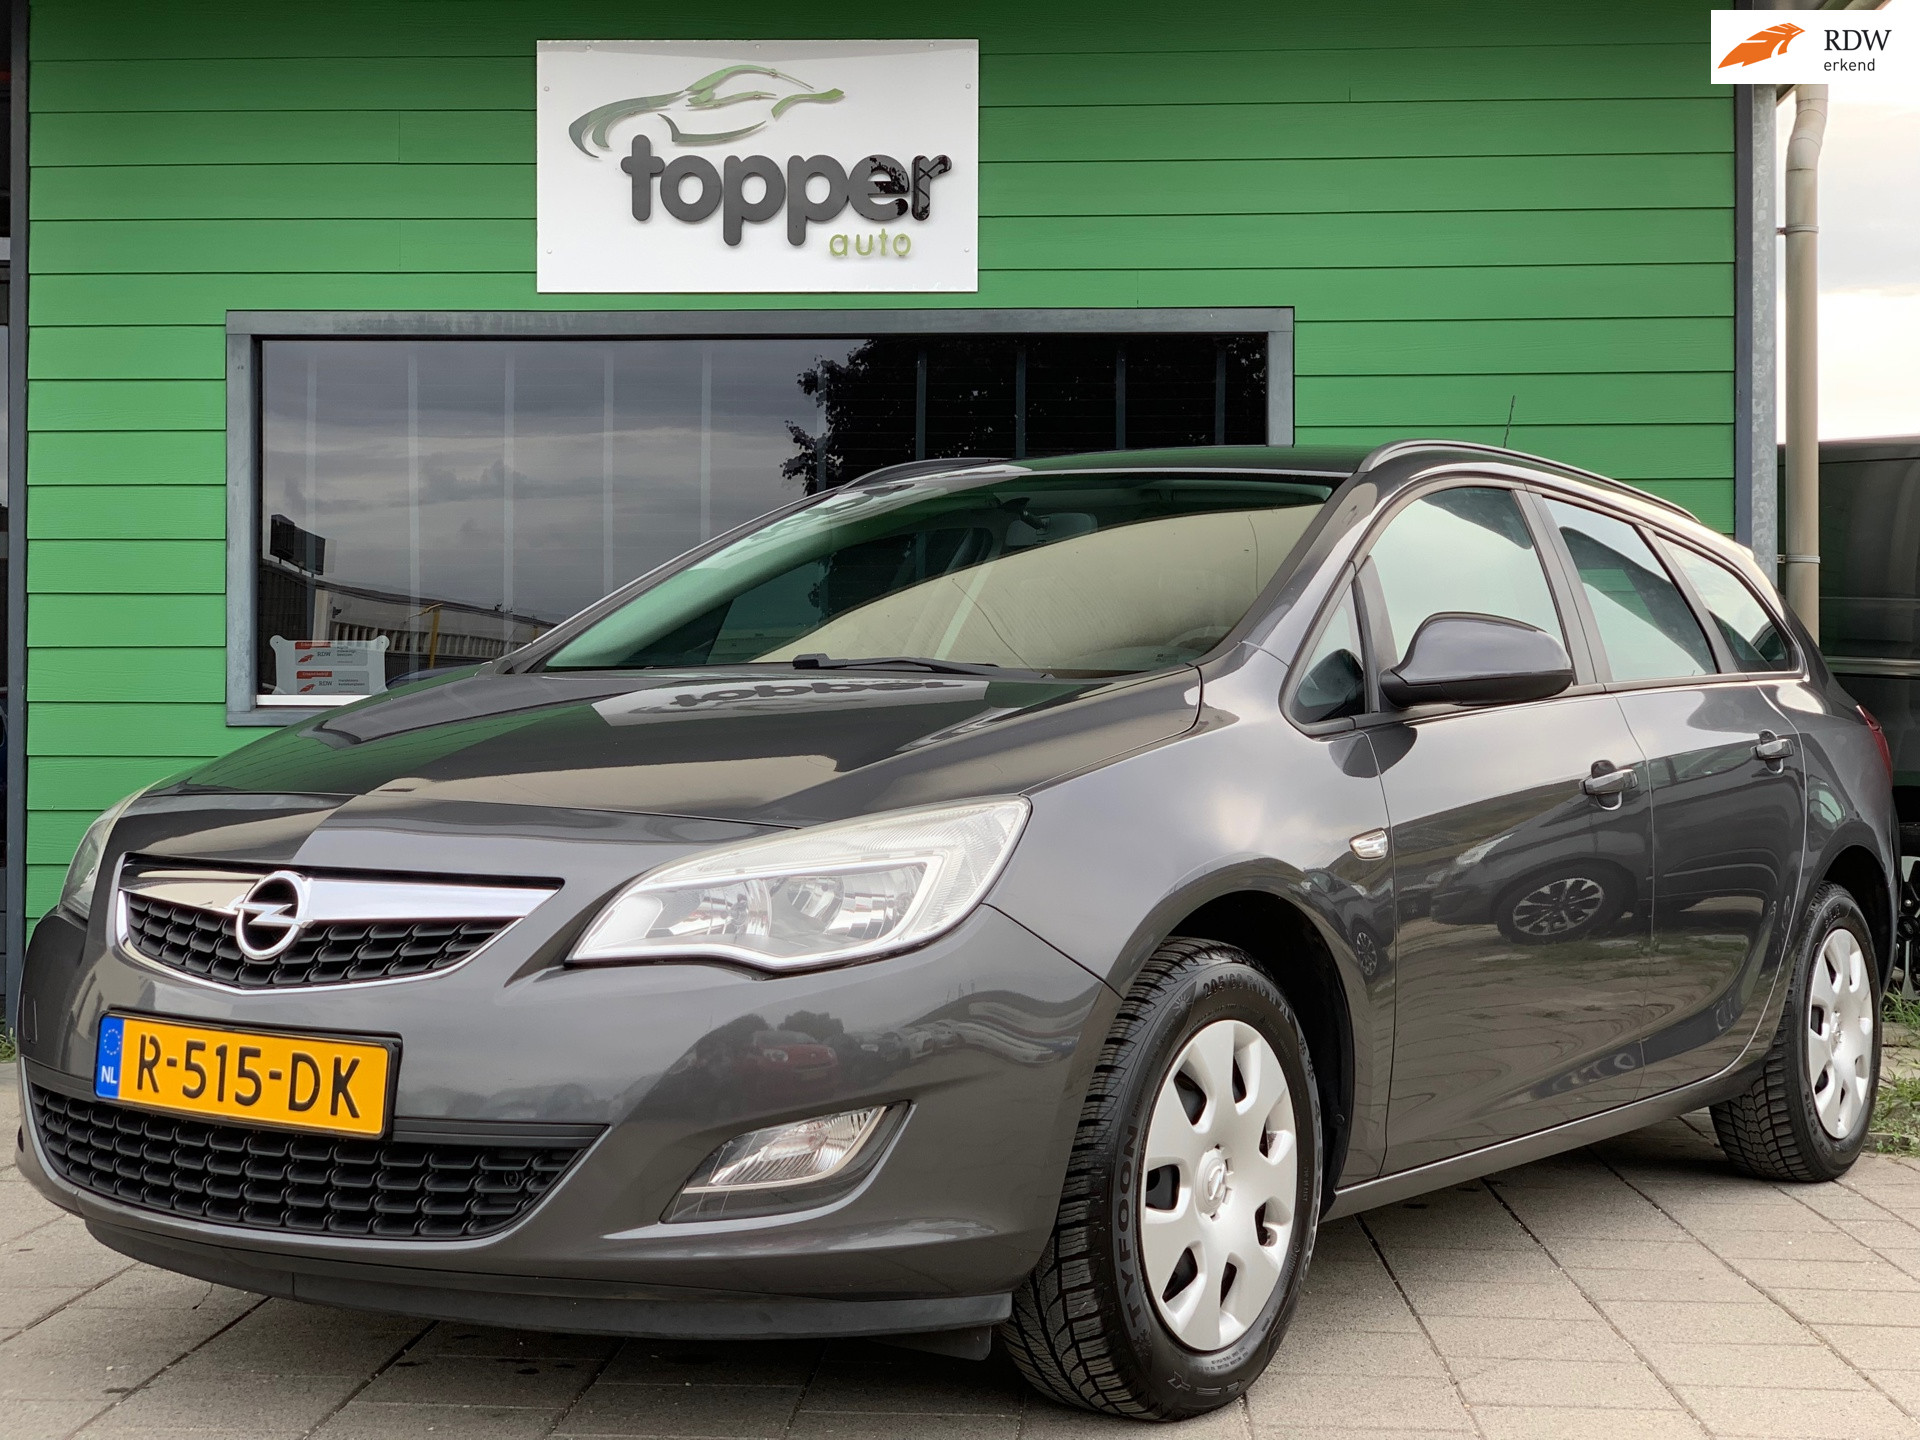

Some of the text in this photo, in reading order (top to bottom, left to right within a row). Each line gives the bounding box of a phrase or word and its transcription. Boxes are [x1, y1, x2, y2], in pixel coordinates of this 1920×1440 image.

[620, 134, 952, 246] topper
[829, 228, 911, 256] auto
[100, 1064, 117, 1085] NL
[136, 1033, 361, 1119] R-515-DK
[1117, 1125, 1142, 1328] TYFOON
